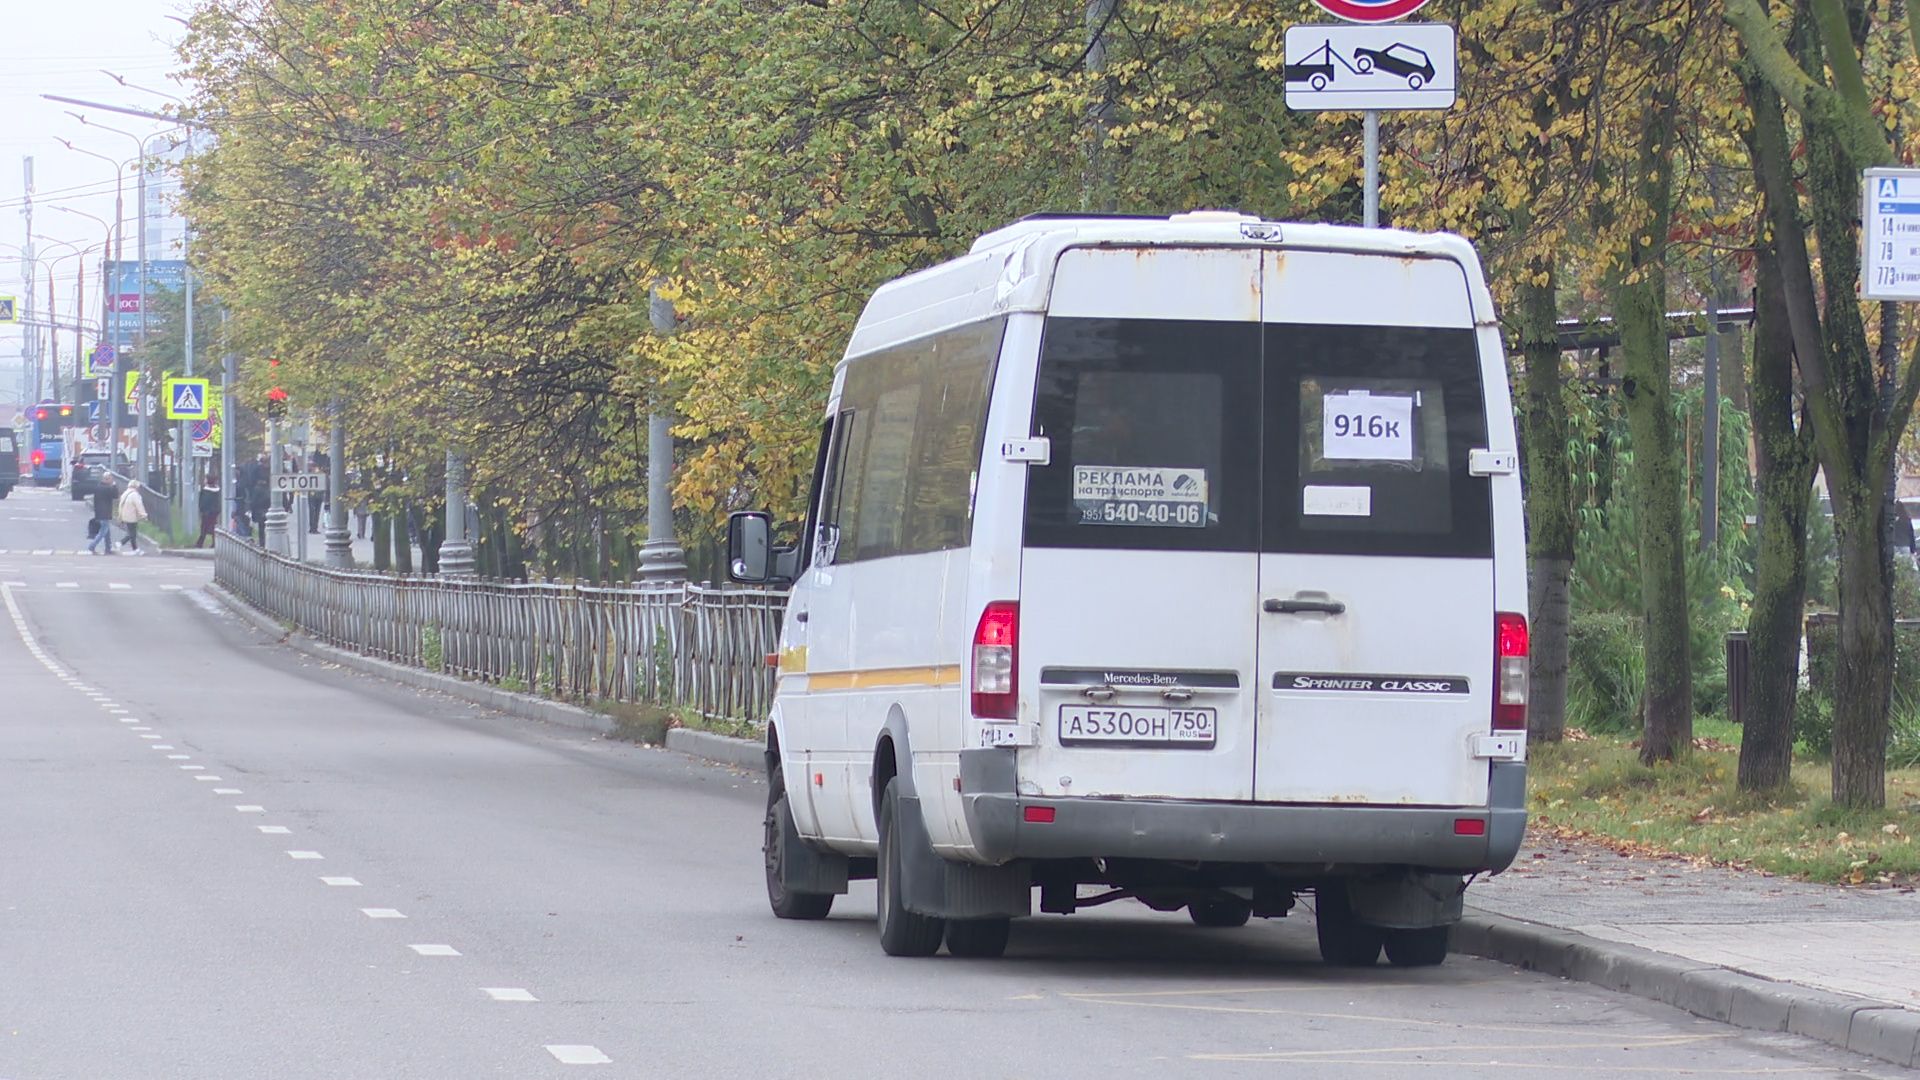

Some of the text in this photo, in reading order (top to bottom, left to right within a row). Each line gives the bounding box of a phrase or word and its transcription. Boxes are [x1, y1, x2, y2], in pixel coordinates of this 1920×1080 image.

[1882, 217, 1893, 236] 14
[1881, 241, 1893, 261] 79
[1877, 266, 1896, 285] 773
[1334, 414, 1400, 438] 916к
[277, 476, 319, 489] СТОП
[1078, 471, 1164, 487] РЕКЛАМА
[1078, 486, 1093, 495] на
[1095, 486, 1165, 498] транспорте
[1104, 502, 1200, 524] 540-40-06
[1103, 672, 1178, 685] Mercedes-Benz
[1171, 711, 1208, 730] 750
[1179, 730, 1198, 738] RUS
